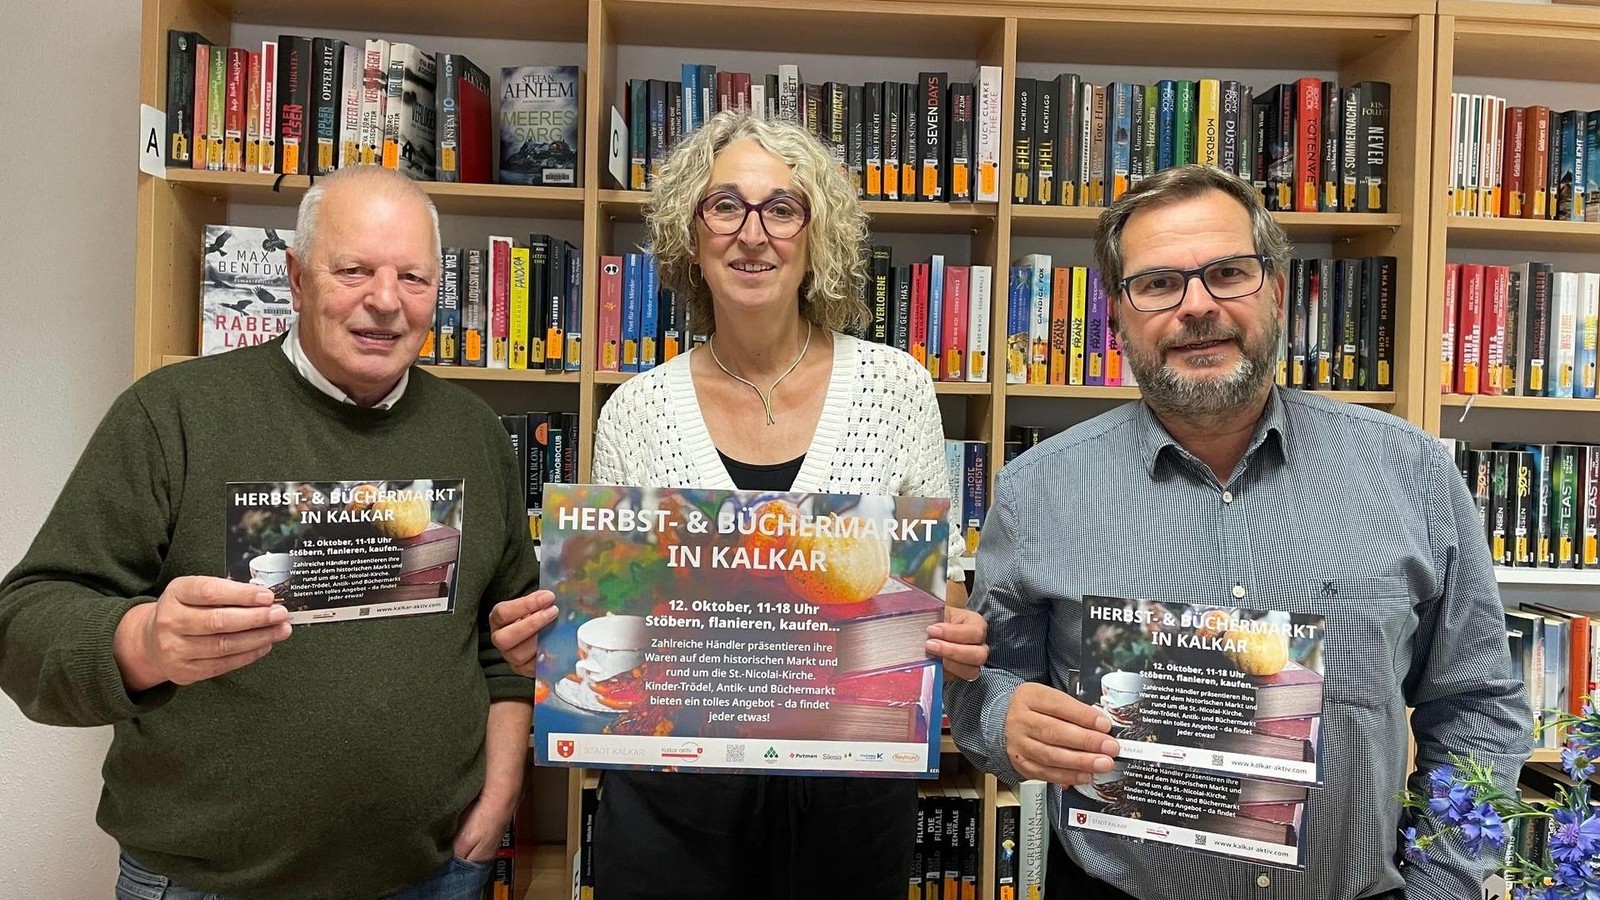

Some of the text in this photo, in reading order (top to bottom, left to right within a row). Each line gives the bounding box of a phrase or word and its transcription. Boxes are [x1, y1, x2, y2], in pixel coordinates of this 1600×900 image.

[322, 47, 333, 100] OPFER 2117
[522, 74, 554, 83] STEFAN
[504, 83, 574, 99] AHNHEM
[443, 98, 455, 112] 10
[832, 89, 843, 133] TOTENARZT
[990, 91, 998, 114] HIKE
[346, 107, 359, 130] TIEFER
[503, 111, 574, 127] MEERES
[1094, 93, 1104, 144] Tote Hand
[1134, 93, 1143, 151] Unterm Schinder
[1146, 107, 1156, 147] Herzschuss
[146, 128, 159, 157] A
[515, 128, 563, 142] SARG
[612, 130, 619, 158] C
[1344, 101, 1357, 169] SOMMERNACHT
[1367, 127, 1384, 164] NEVER
[1575, 139, 1584, 183] NORDLICHT
[237, 250, 269, 262] MAX
[218, 261, 287, 275] BENTOW
[468, 250, 480, 303] EVA ALMSTÄDT
[445, 254, 457, 309] EVA ALMSTÄDT
[876, 275, 886, 337] DIE VERLORENE
[215, 315, 287, 333] RABEN
[900, 326, 906, 337] DU
[1055, 319, 1065, 350] FRANZ
[1074, 318, 1082, 348] FRANZ
[1092, 319, 1101, 349] FRANZ
[530, 473, 538, 495] FELIX
[953, 455, 961, 508] SOMMERFRISCHE
[967, 467, 975, 487] TOTE
[975, 457, 983, 507] RITTMEISTER
[234, 488, 456, 507] HERBST- & BÜCHERMARKT
[1562, 479, 1572, 518] EAST
[1589, 479, 1598, 518] EAST
[300, 509, 394, 525] IN KALKAR
[558, 507, 938, 542] HERBST- & BÜCHERMARKT
[289, 548, 326, 558] Stöbern,
[326, 546, 368, 556] flanieren,
[303, 539, 316, 548] 12.
[317, 538, 354, 547] Oktober,
[355, 537, 376, 545] 11-18
[293, 559, 325, 568] Zahlreiche
[326, 557, 349, 566] Händler
[350, 556, 388, 565] präsentieren
[667, 545, 828, 573] IN KALKAR
[668, 600, 819, 615] 12. Oktober, 11-18 Uhr
[645, 615, 841, 632] Stöbern, flanieren, kaufen...
[1090, 605, 1317, 640] HERBST- & BÜCHERMARKT
[651, 638, 833, 653] Zahlreiche Händler präsentieren ihre
[1151, 632, 1248, 653] IN KALKAR
[645, 652, 838, 667] Waren auf dem historischen Markt und
[1152, 662, 1246, 679] 12. Oktober, 11-18 Uhr
[666, 668, 816, 680] rund um die St.-Nicolai-Kirche.
[1139, 670, 1259, 690] Stöbern, flanieren, kaufen...
[645, 681, 835, 695] Kinder-Trödel, Antik- und Büchermarkt
[650, 696, 682, 706] bieten
[684, 697, 700, 706] ein
[703, 697, 729, 707] tolles
[732, 698, 775, 710] Angebot
[784, 699, 797, 709] da
[799, 699, 829, 710] findet
[708, 711, 770, 723] jeder etwas!
[584, 747, 645, 757] STADT KALKAR
[1231, 759, 1308, 775] www.kalkar-aktiv.com
[916, 810, 924, 844] FILIALE
[927, 817, 935, 833] DIE
[934, 808, 943, 842] FILIALE
[951, 810, 959, 847] ZENTRALE
[1026, 817, 1035, 866] GRISHAM
[1034, 792, 1043, 885] DAS BEKENNTNIS
[1213, 839, 1289, 858] www.kalkar-aktiv.com
